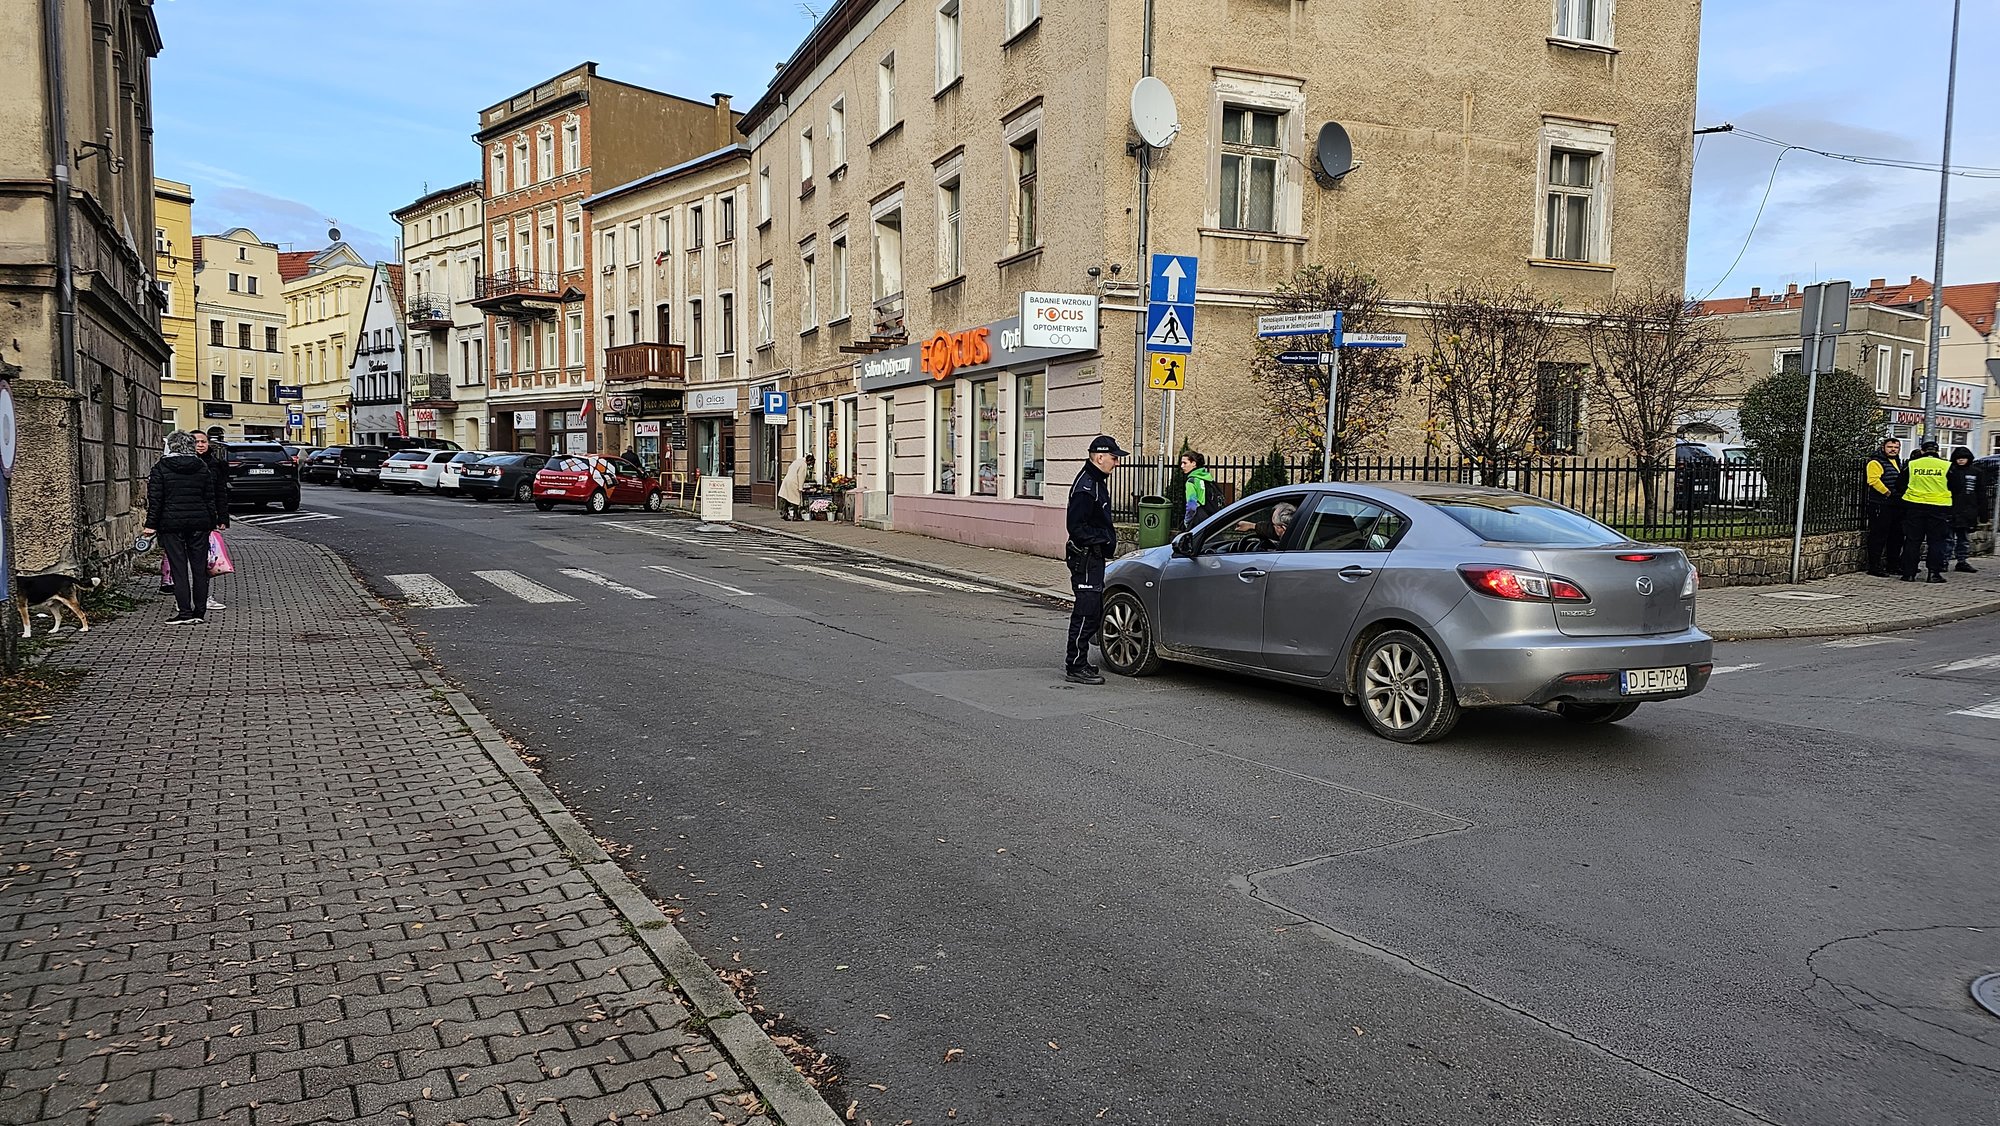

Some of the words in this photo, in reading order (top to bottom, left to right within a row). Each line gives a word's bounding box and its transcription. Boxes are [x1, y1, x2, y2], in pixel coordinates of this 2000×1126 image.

[1030, 296, 1060, 305] BADANIE
[1062, 298, 1092, 306] WZROKU
[1037, 307, 1084, 322] FOCUS
[1033, 323, 1087, 333] OPTOMETRYSTA
[864, 361, 881, 379] Salon
[881, 356, 912, 379] Optyczny
[920, 328, 992, 381] FOCUS
[706, 394, 725, 403] alias
[769, 394, 783, 412] P
[1940, 386, 1972, 410] MEBLE
[292, 414, 301, 424] P
[416, 410, 434, 420] Kodak
[643, 424, 659, 433] ITAKA
[1913, 467, 1942, 477] POLICJA
[1629, 670, 1657, 689] DJE
[1660, 668, 1686, 687] 7P64
